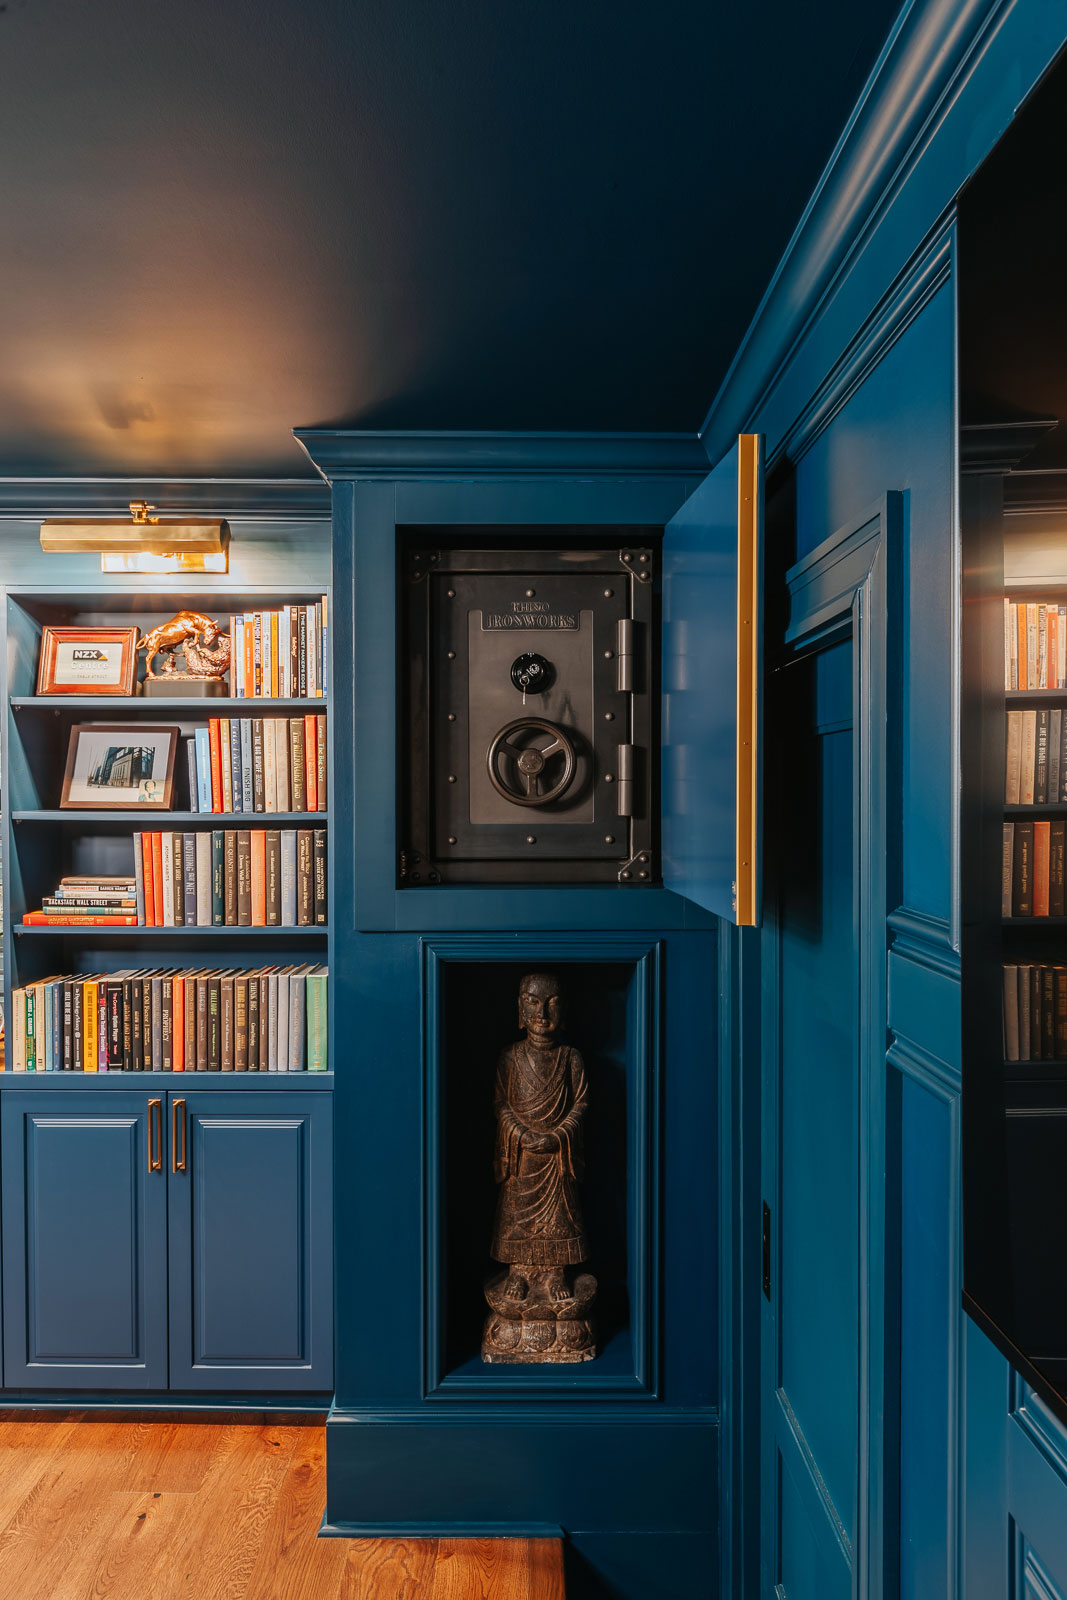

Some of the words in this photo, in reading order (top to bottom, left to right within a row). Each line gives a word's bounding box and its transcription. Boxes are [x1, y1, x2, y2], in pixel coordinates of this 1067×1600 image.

[511, 602, 550, 612] RHINO
[488, 614, 575, 628] IRONWORKS
[294, 745, 303, 782] MILLIONAIRE
[294, 783, 302, 798] MIND
[186, 882, 194, 895] NET
